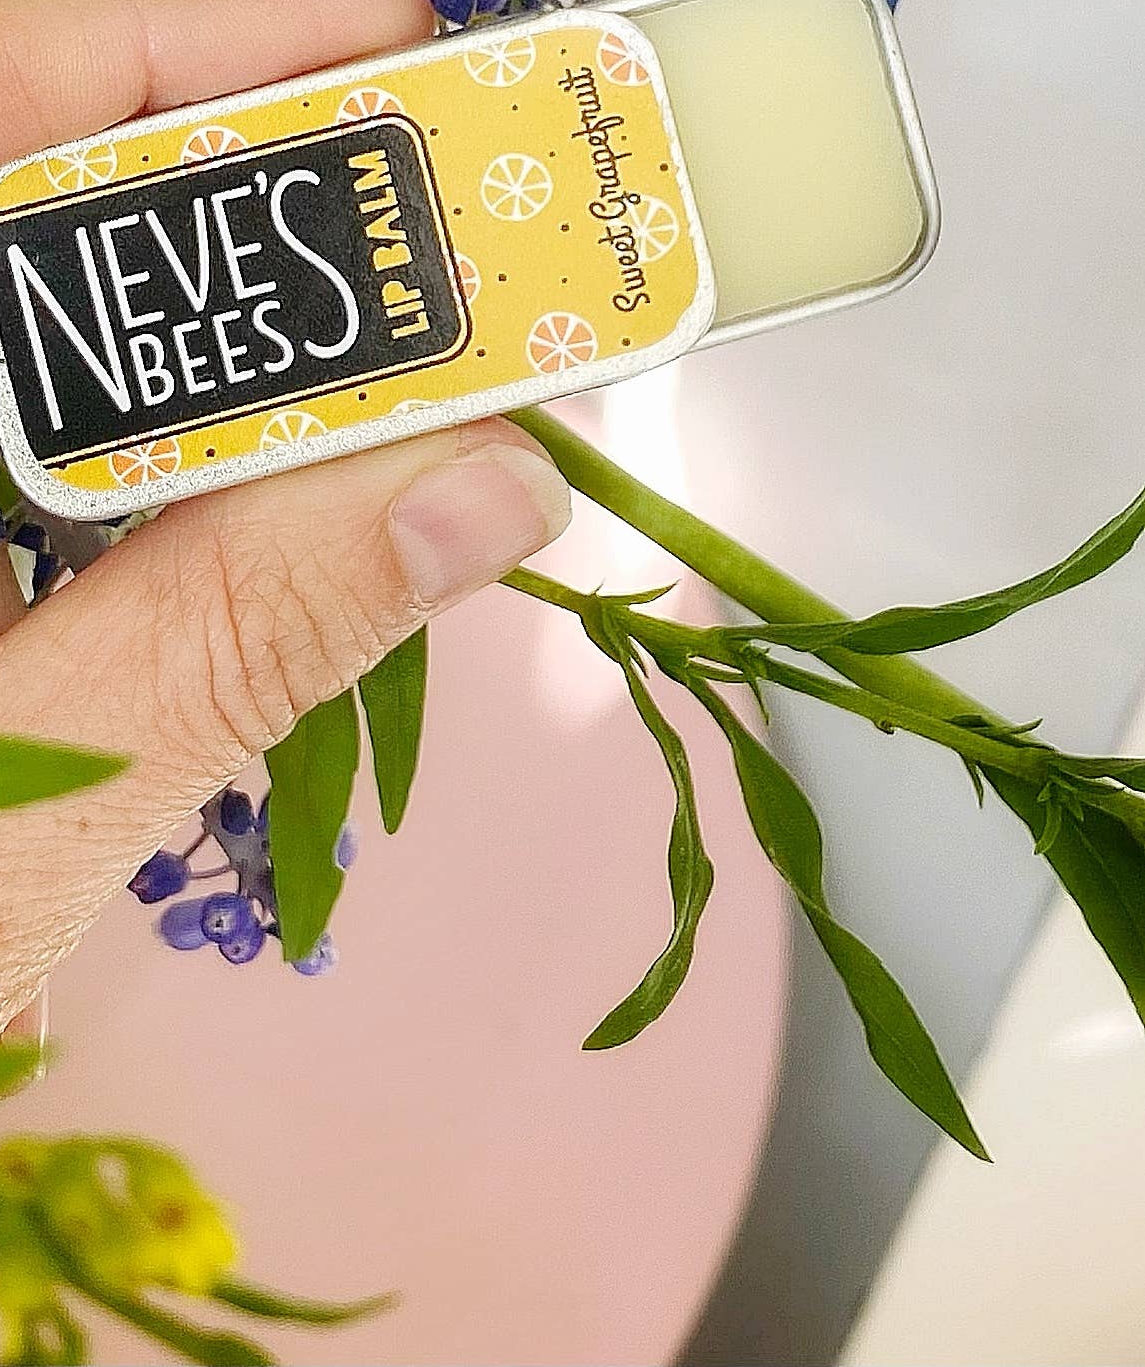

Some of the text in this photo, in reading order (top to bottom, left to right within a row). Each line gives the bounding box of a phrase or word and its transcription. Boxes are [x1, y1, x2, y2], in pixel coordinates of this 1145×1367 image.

[346, 148, 431, 340] LIP BALM
[558, 66, 651, 313] Sweet Grapefruit
[6, 169, 359, 433] NEVE'S
[124, 298, 295, 409] BEES
